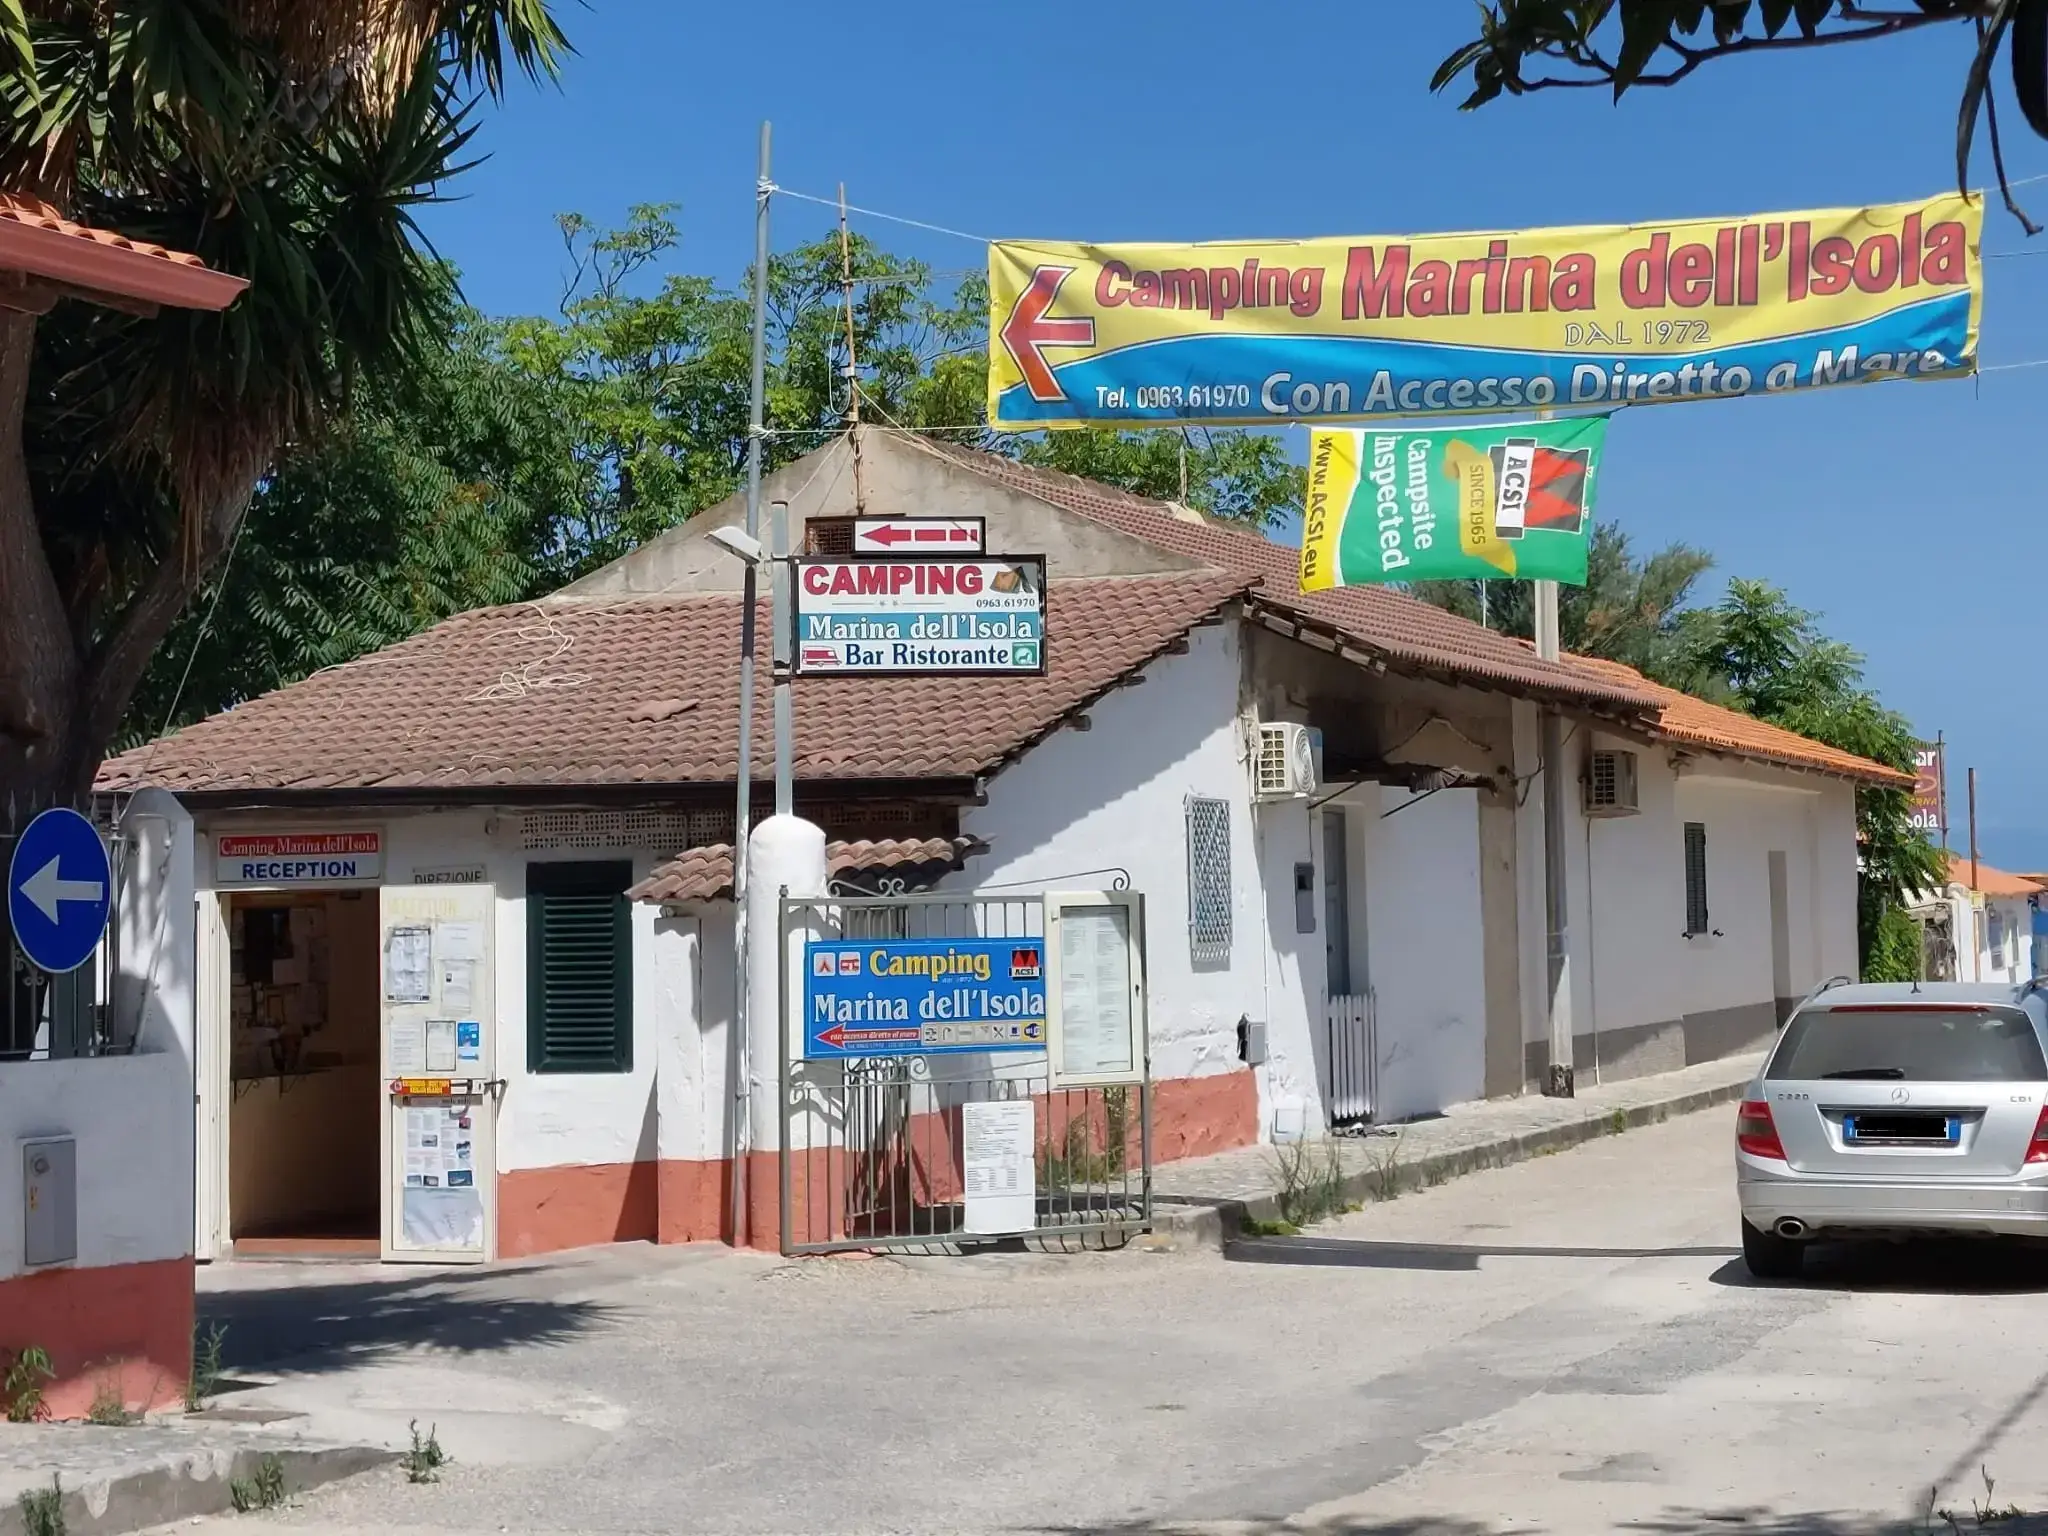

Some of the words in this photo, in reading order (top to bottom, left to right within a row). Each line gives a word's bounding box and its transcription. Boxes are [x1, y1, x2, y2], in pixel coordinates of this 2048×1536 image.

[1094, 257, 1325, 321] Camping
[1341, 239, 1597, 321] Marina
[1619, 210, 1968, 310] dell'Isola
[1565, 321, 1632, 347] DAL
[1643, 319, 1712, 345] 1972
[1260, 371, 1351, 414] Con
[1362, 370, 1557, 413] Accesso
[1570, 359, 1752, 403] Diretto
[1765, 369, 1799, 392] a
[1811, 344, 1952, 387] Mare
[1095, 385, 1131, 410] Tel.
[1136, 383, 1251, 411] 0963.61970
[1407, 437, 1437, 551] Campsite
[1469, 464, 1484, 509] SINCE
[1502, 455, 1527, 511] ACSI
[1303, 435, 1334, 580] www.ACSI.eu
[1369, 435, 1411, 573] inspected
[1471, 510, 1487, 545] 1965
[803, 565, 984, 596] CAMPING
[976, 599, 1001, 609] 0963
[1004, 598, 1036, 608] 61970
[808, 615, 901, 640] Marina
[910, 613, 1033, 640] dell'Isola
[845, 643, 885, 666] Bar
[892, 643, 1010, 666] Ristorante
[221, 839, 275, 859] Camping
[276, 837, 321, 853] Marina
[322, 834, 377, 852] dell'Isola
[242, 860, 357, 880] RECEPTION
[869, 947, 992, 983] Camping
[814, 991, 909, 1023] Marina
[918, 986, 1046, 1020] dell'Isola
